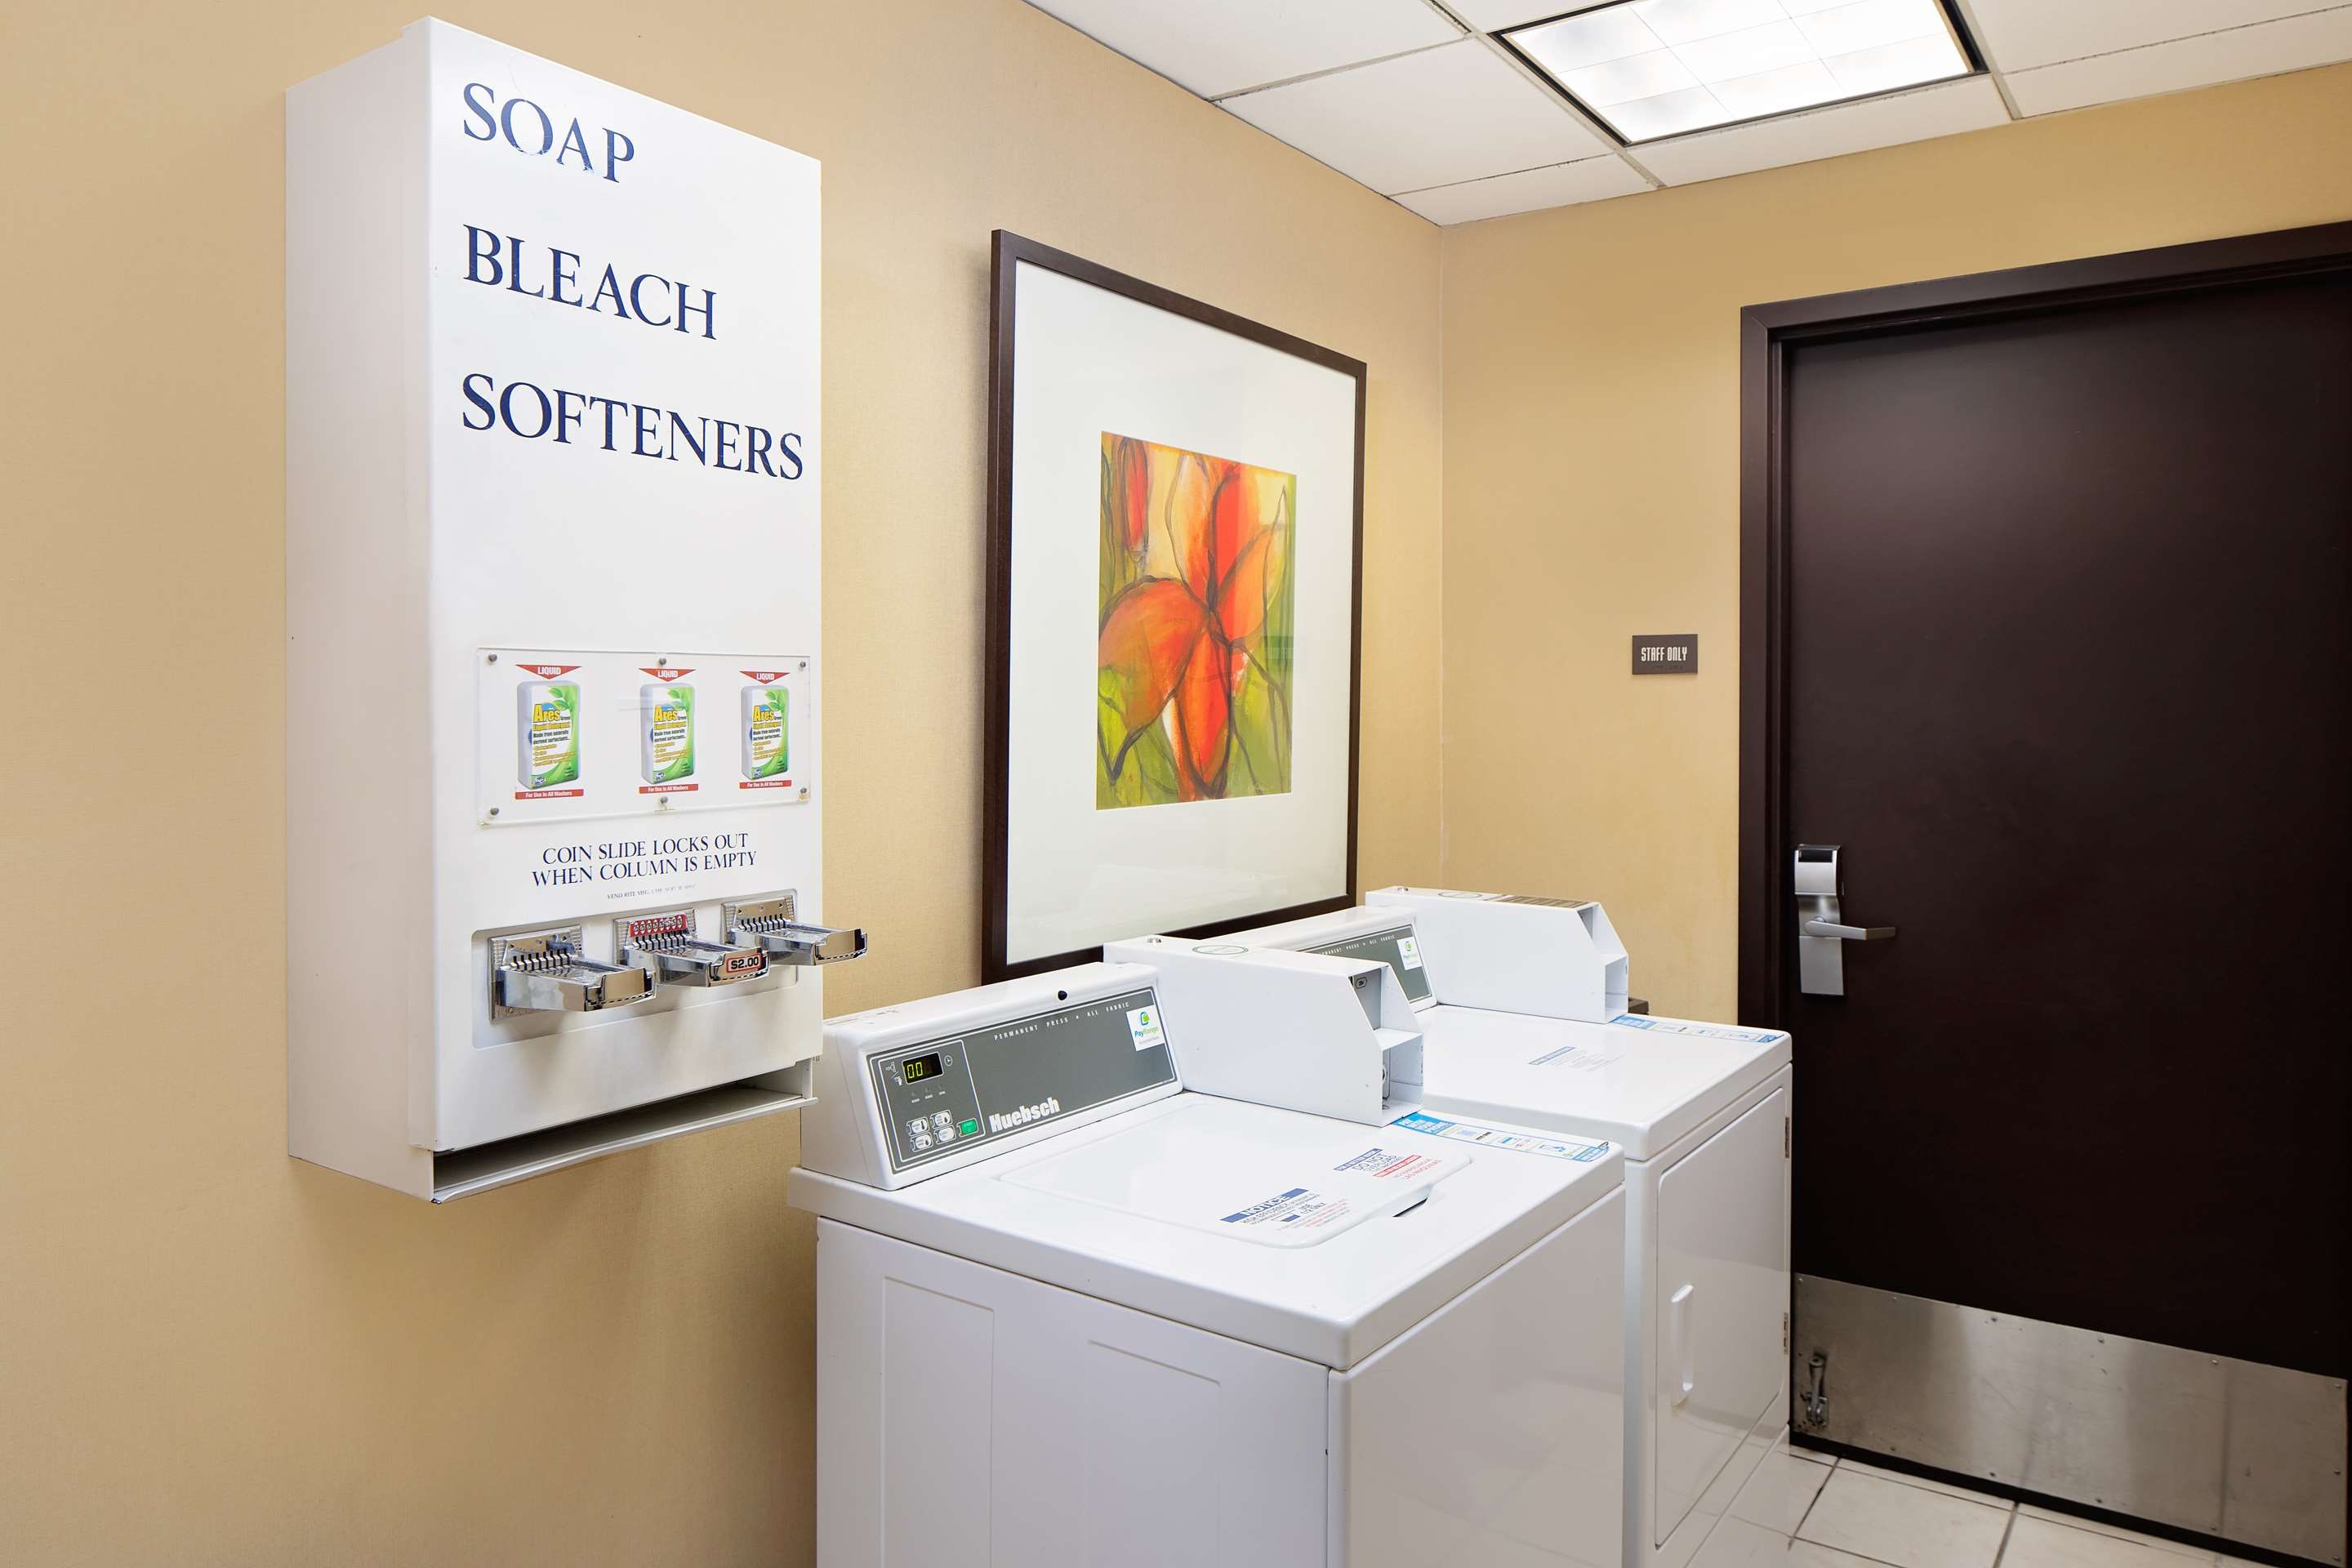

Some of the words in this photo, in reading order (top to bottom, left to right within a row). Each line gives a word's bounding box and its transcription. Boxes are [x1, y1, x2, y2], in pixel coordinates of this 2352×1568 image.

[462, 82, 635, 183] SOAP
[462, 224, 717, 340] BLEACH
[461, 372, 804, 480] SOFTENERS
[1641, 647, 1665, 662] STAFF
[1667, 646, 1688, 662] ONLY
[537, 666, 562, 675] LIQUID
[657, 670, 679, 679] LIQUID
[756, 673, 775, 681] LIQUID
[533, 703, 560, 723] Ares
[654, 705, 678, 722] Ares
[753, 705, 774, 722] Ares
[542, 844, 592, 865] COIN
[599, 840, 647, 860] SLIDE
[653, 835, 709, 855] LOCKS
[715, 833, 748, 849] OUT
[532, 866, 593, 887] WHEN
[599, 857, 678, 880] COLUMN
[684, 856, 697, 872] IS
[704, 850, 757, 871] EMPTY
[731, 956, 760, 969] $2.00
[994, 1024, 1039, 1041] PERMANENT
[1046, 1017, 1069, 1028] PRESS
[1087, 1009, 1099, 1018] ALL
[1106, 1001, 1129, 1013] FABRIC
[906, 1062, 924, 1079] 00
[988, 1097, 1061, 1134] Huebsch
[1239, 1195, 1291, 1217] NOTICE
